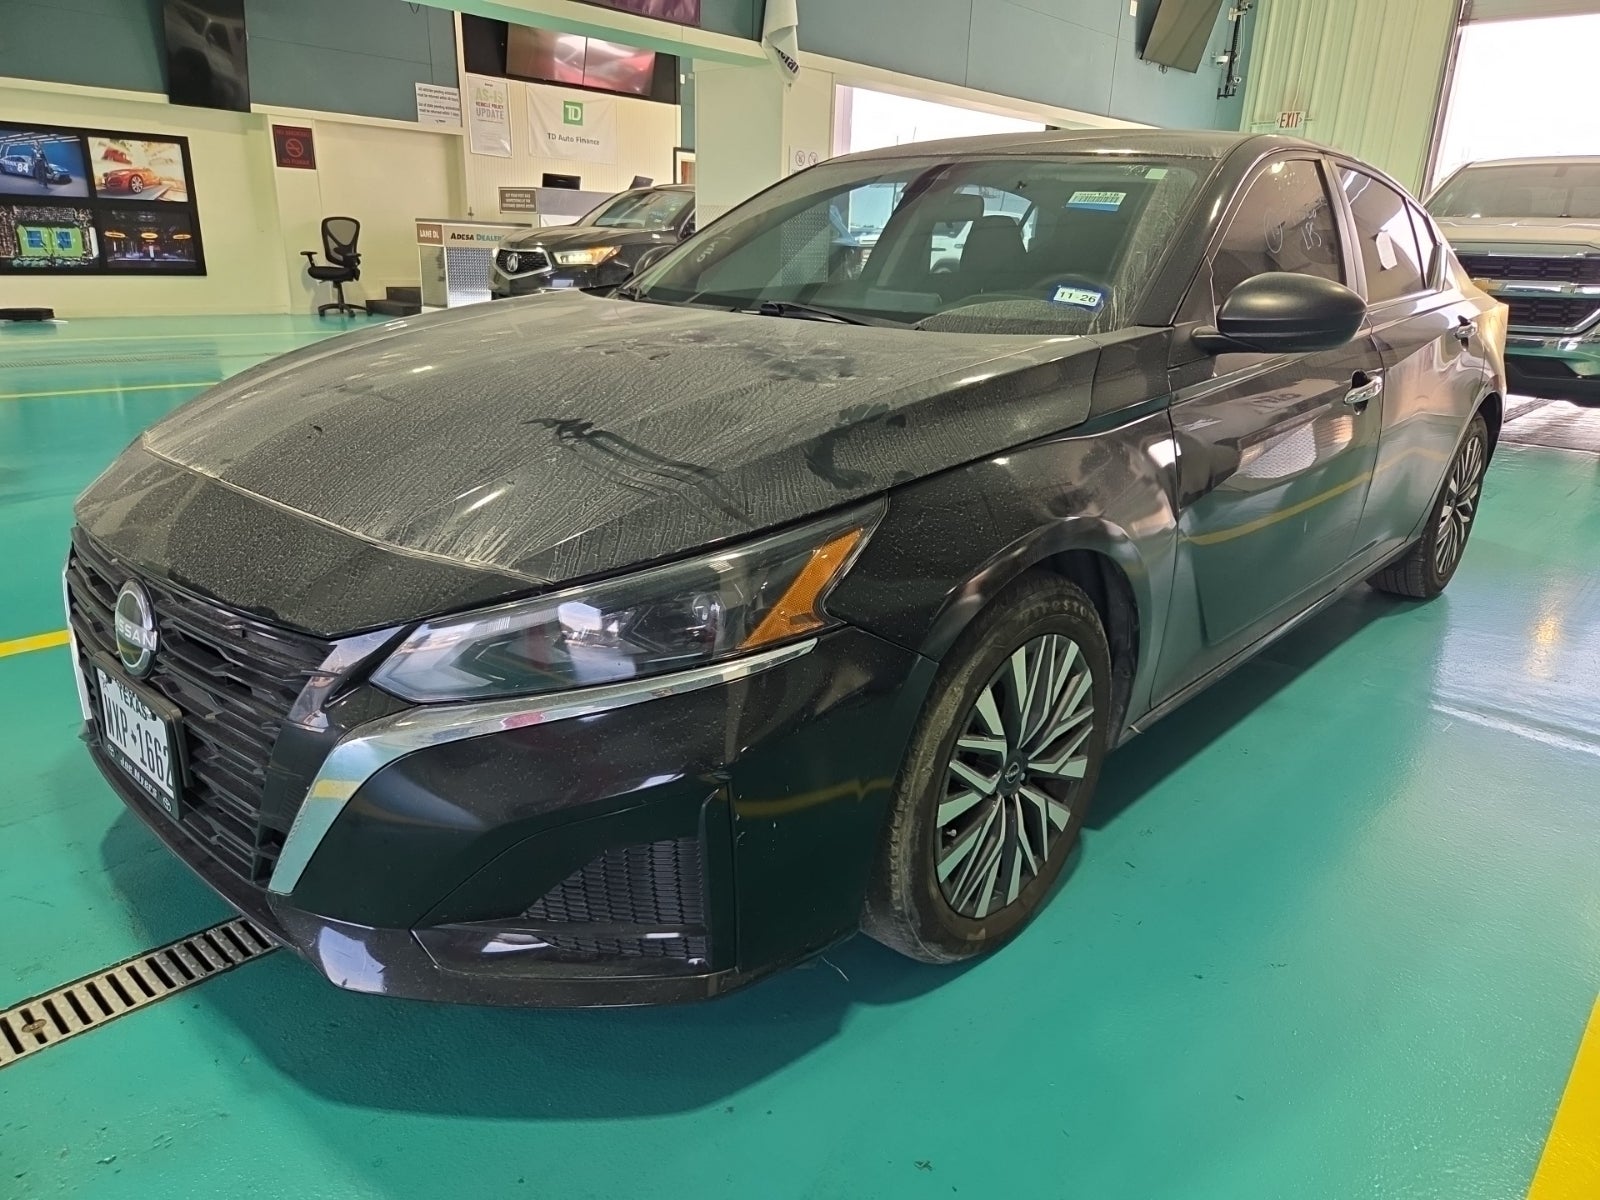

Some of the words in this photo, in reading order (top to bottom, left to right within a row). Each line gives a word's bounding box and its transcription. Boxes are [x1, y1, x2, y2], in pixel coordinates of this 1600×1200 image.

[476, 107, 504, 120] UPDATE
[564, 104, 582, 121] TD
[1279, 112, 1301, 128] EXIT
[547, 132, 557, 140] TD
[558, 134, 575, 143] Auto
[575, 136, 600, 146] Finance
[17, 162, 29, 173] 84
[450, 232, 475, 241] ADESA
